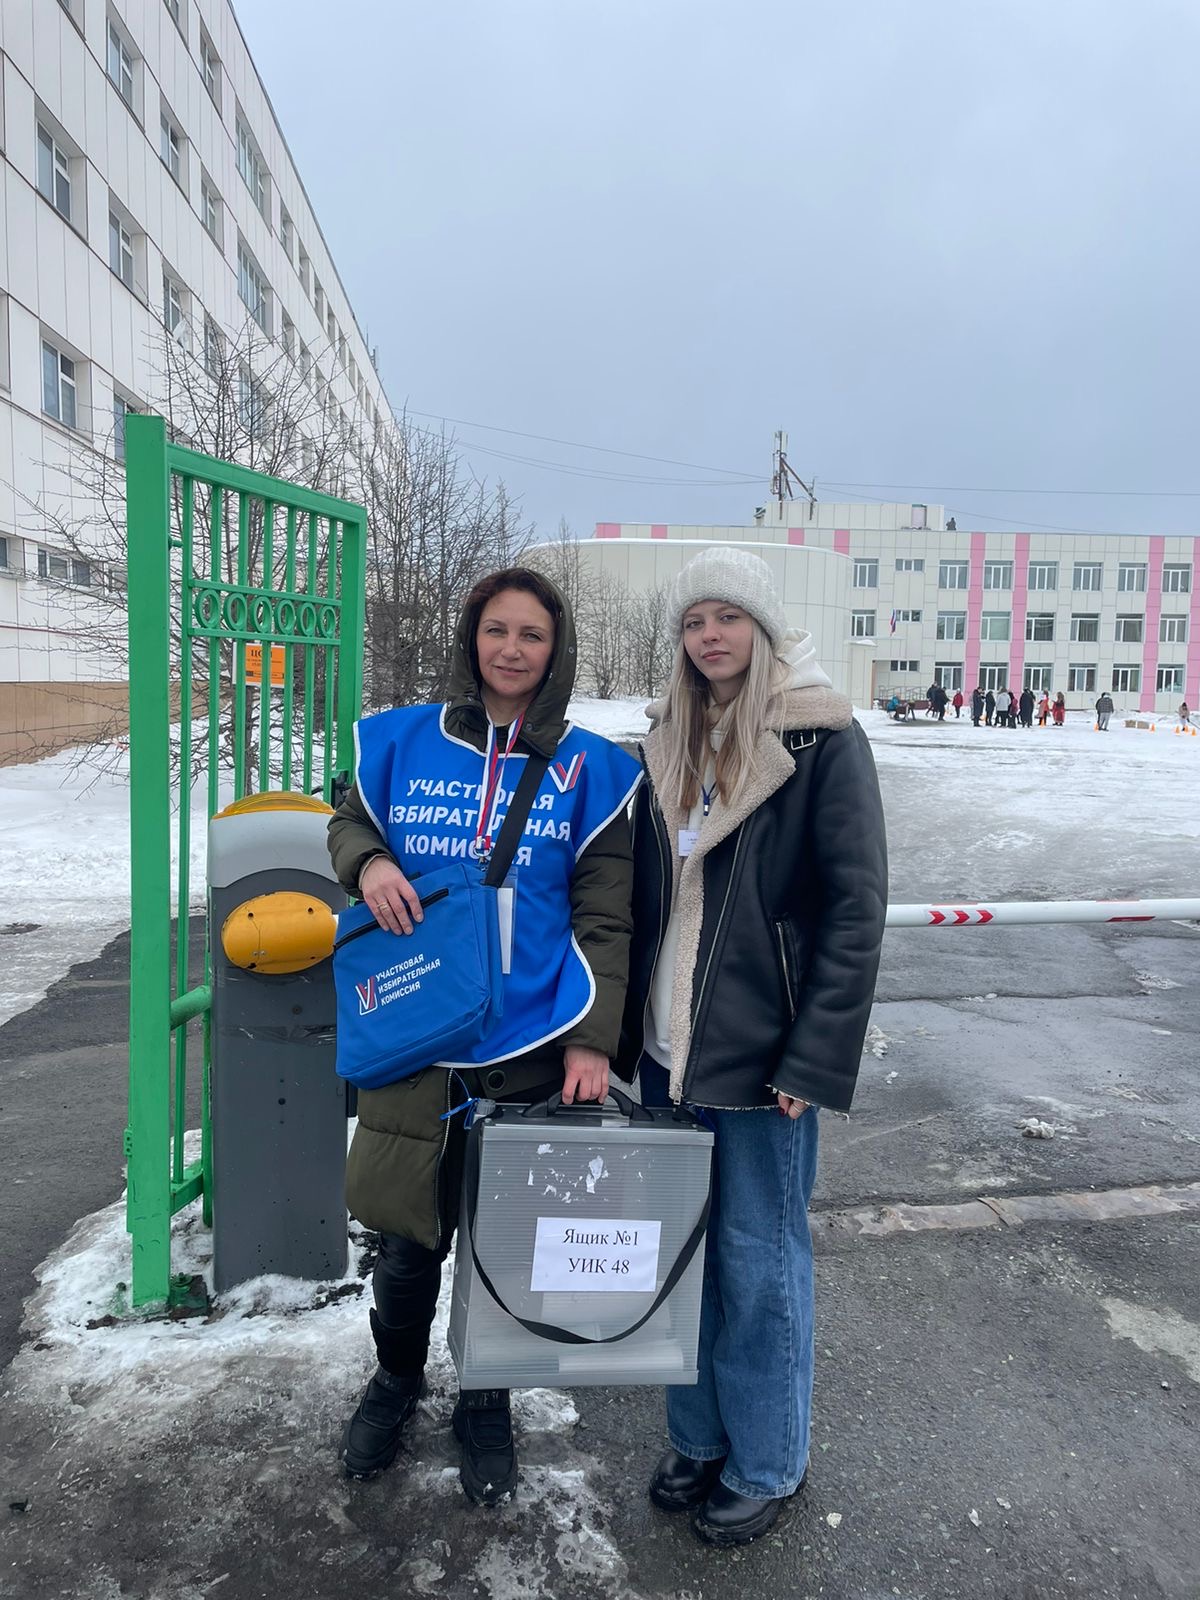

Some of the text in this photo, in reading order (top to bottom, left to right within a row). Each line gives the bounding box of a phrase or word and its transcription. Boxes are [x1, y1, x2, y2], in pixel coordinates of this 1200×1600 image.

[407, 778, 554, 811] УЧАСТОЯ
[375, 953, 424, 982] УЧАСТКОВАЯ
[378, 958, 441, 994] ИЗБИРАТЕЛЬНАЯ
[380, 981, 421, 1007] КОМИССИЯ
[562, 1228, 638, 1246] Ящик №1
[568, 1257, 630, 1274] УИК 48
